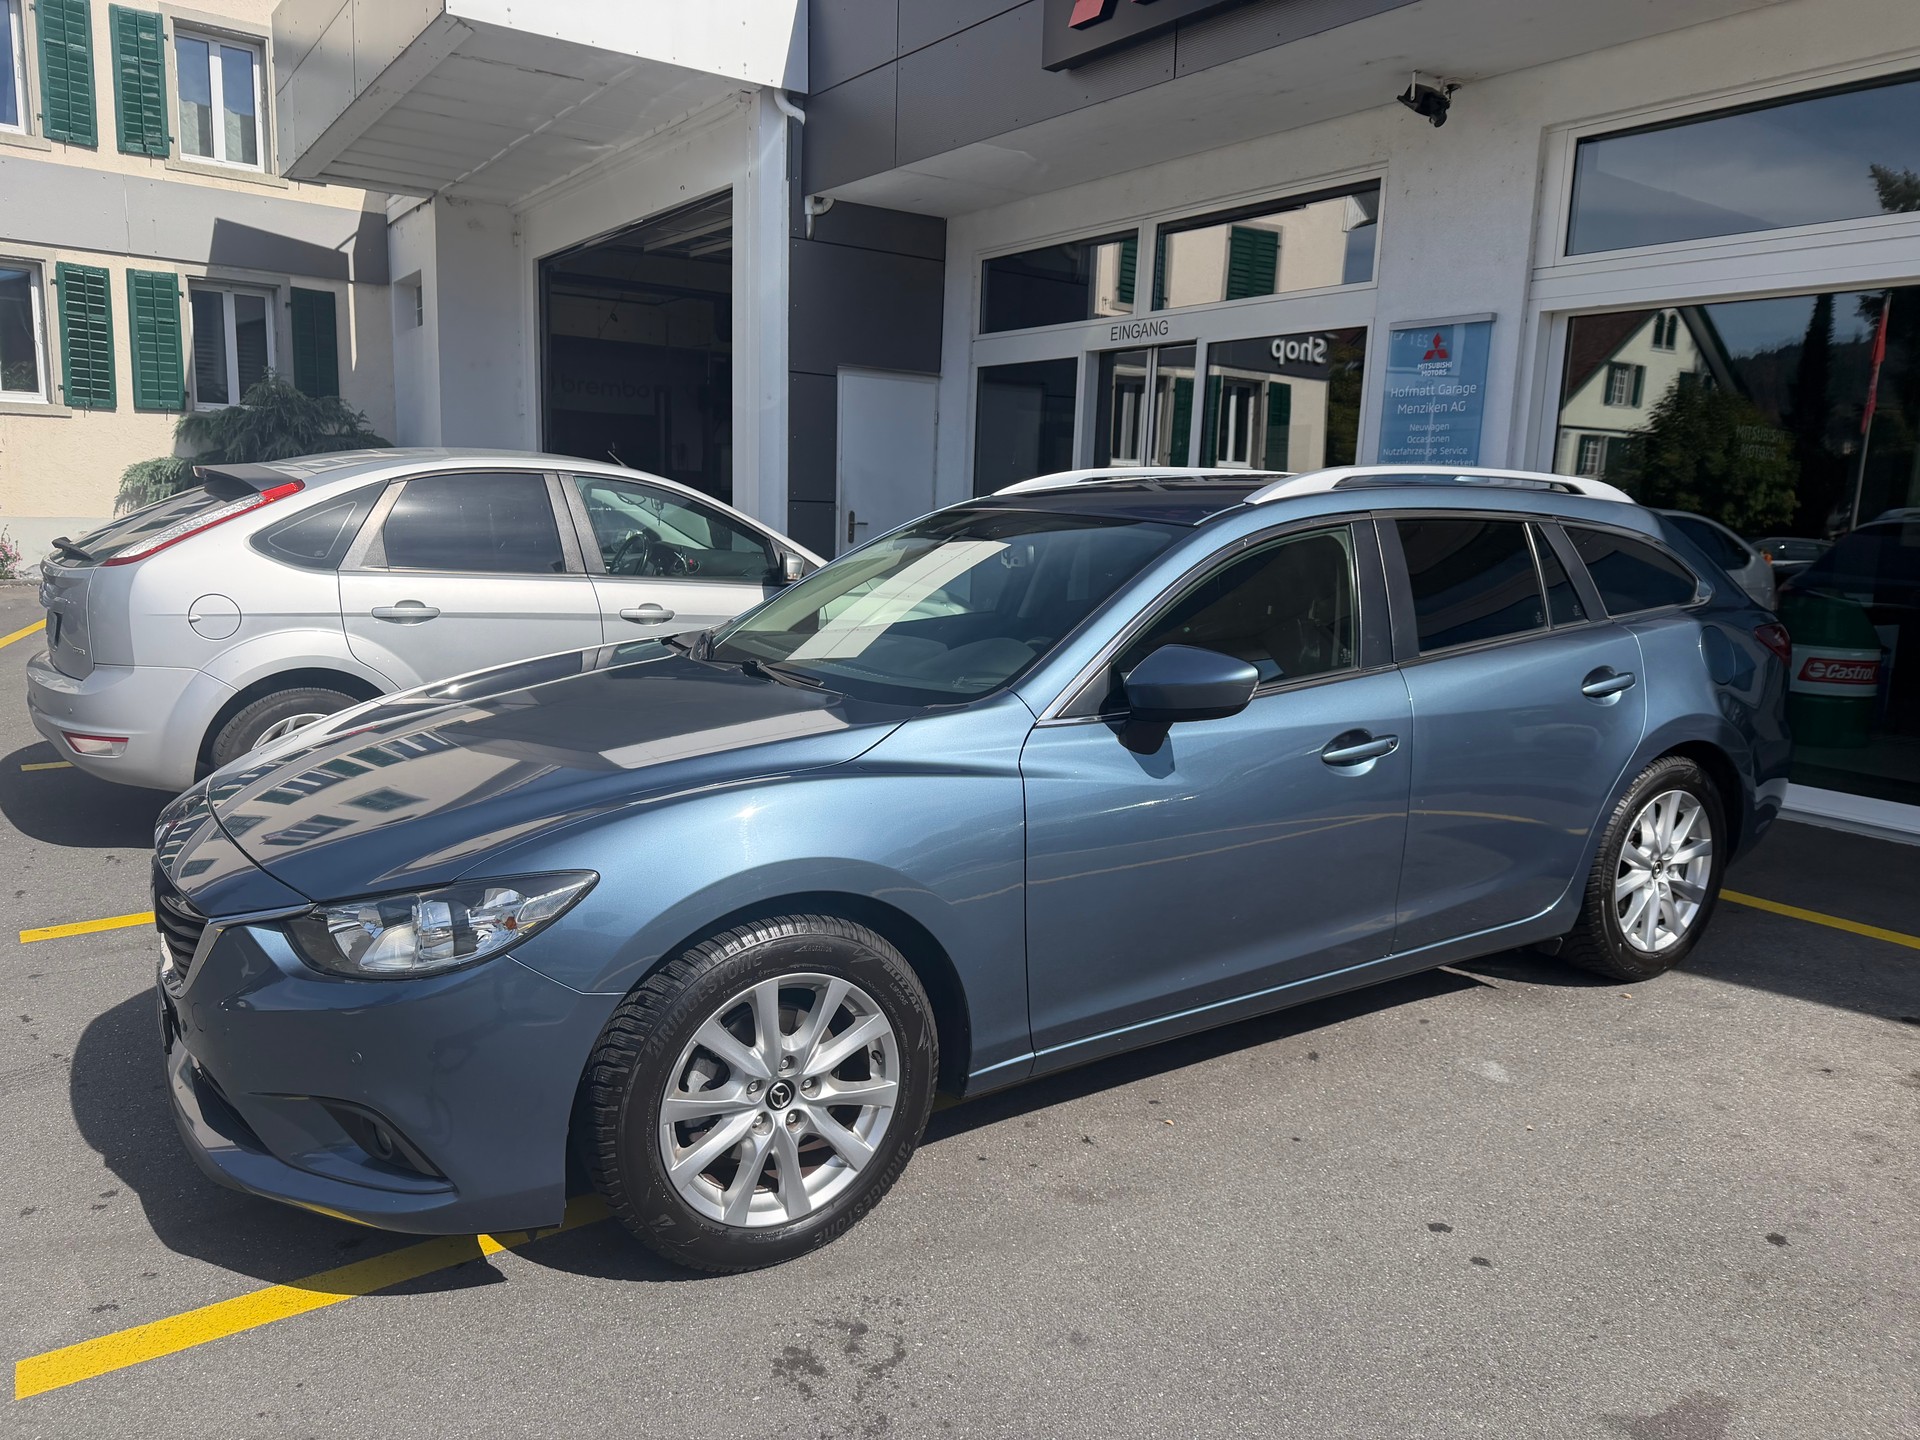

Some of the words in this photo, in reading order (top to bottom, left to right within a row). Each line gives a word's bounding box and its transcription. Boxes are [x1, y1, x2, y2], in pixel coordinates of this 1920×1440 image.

[1110, 320, 1169, 341] EINGANG
[1417, 361, 1453, 370] MITSUBISHI
[561, 373, 650, 398] brembo
[1391, 385, 1435, 398] Hofmatt
[1438, 384, 1477, 396] Garage
[1397, 402, 1447, 414] Menziken
[1450, 400, 1466, 412] AG
[1409, 423, 1450, 432] Neuwagen
[1406, 435, 1450, 443] Occasionen
[1383, 446, 1437, 456] Nutzfahrzeuge
[1440, 446, 1468, 455] Service
[1826, 664, 1876, 680] Castrol
[882, 962, 922, 1014] BLIZZAK
